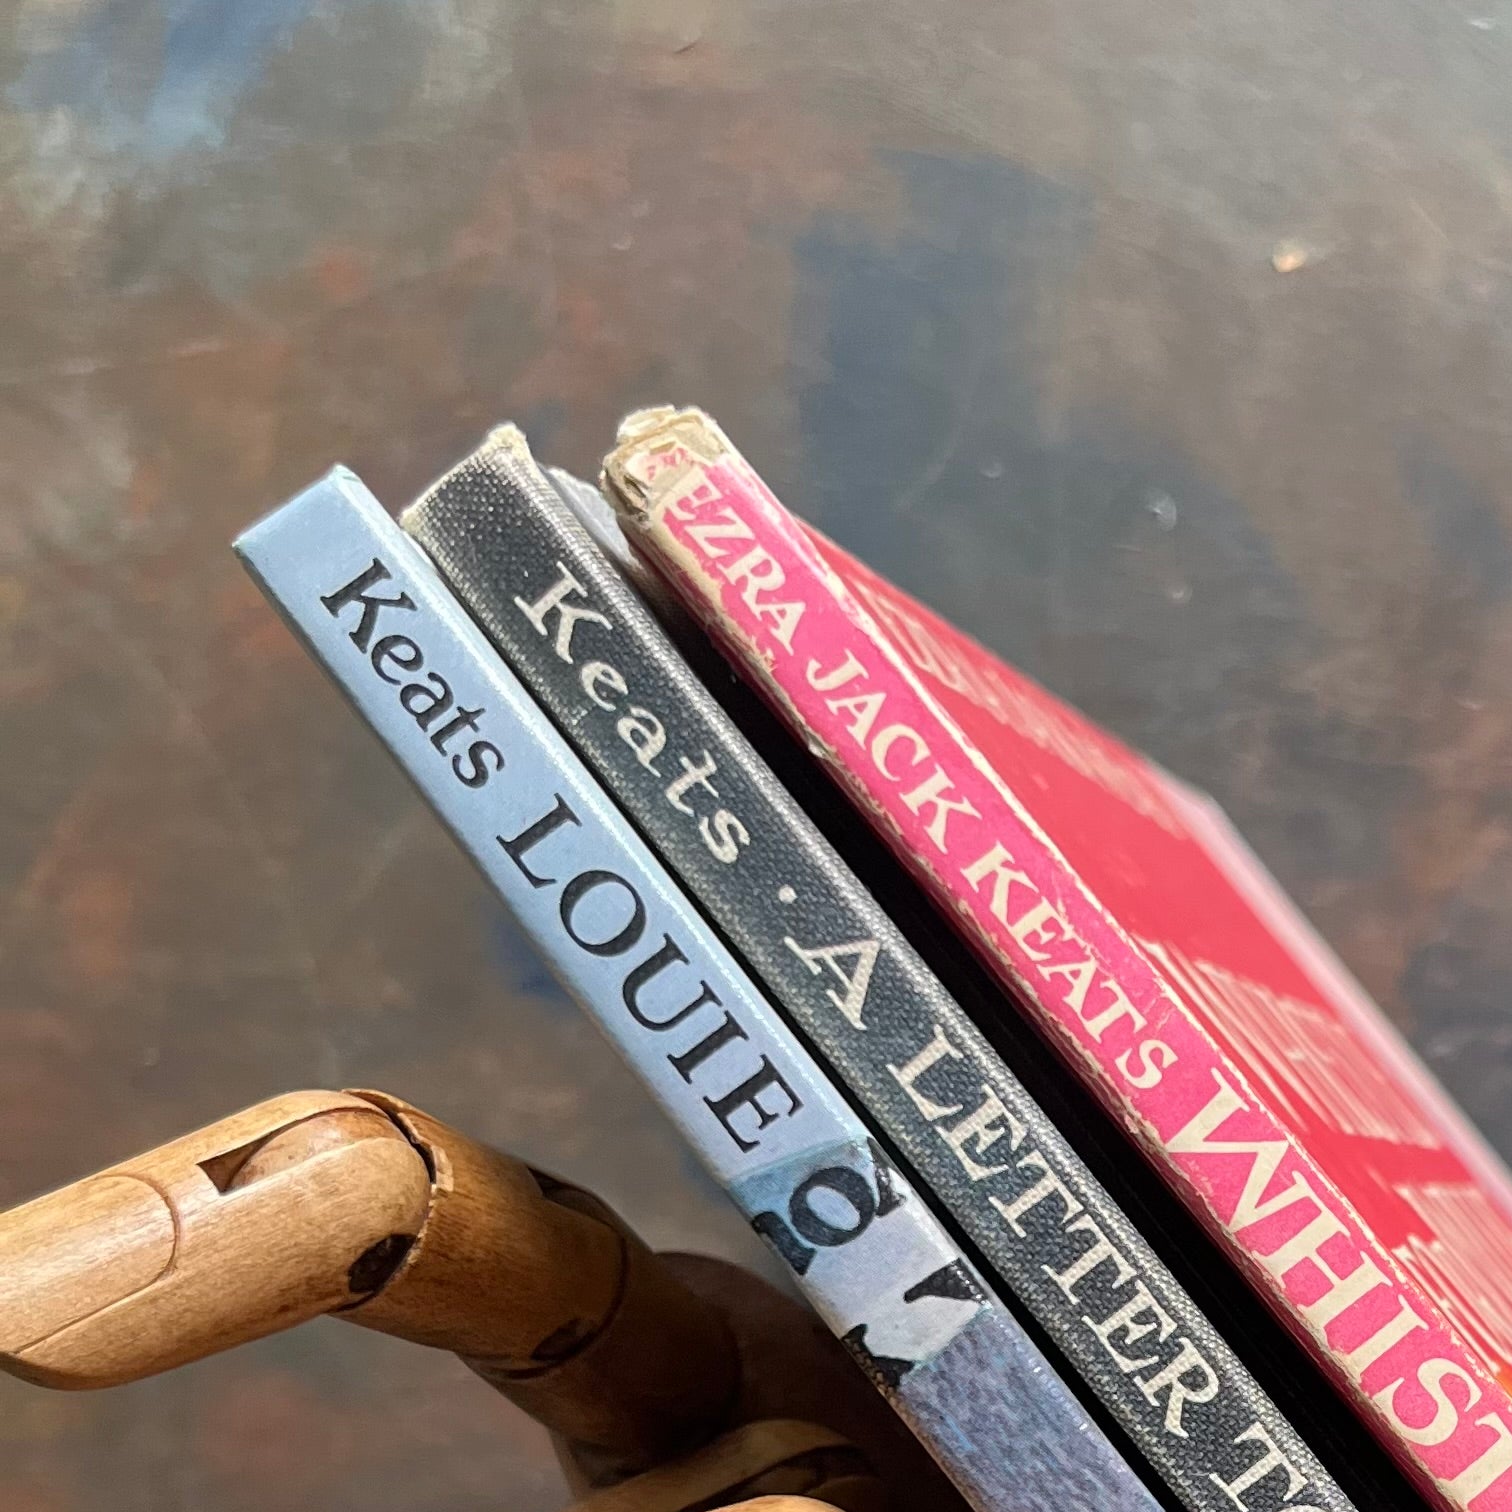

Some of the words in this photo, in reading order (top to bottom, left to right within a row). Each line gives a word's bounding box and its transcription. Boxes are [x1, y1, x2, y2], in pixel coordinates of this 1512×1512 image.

[320, 556, 506, 790] Keats
[495, 792, 806, 1154] LOUIE
[513, 560, 752, 866] Keats
[783, 932, 884, 1030] A
[886, 1026, 1220, 1440] LETTER
[808, 648, 982, 854] JACK
[962, 840, 1180, 1092] KEATS
